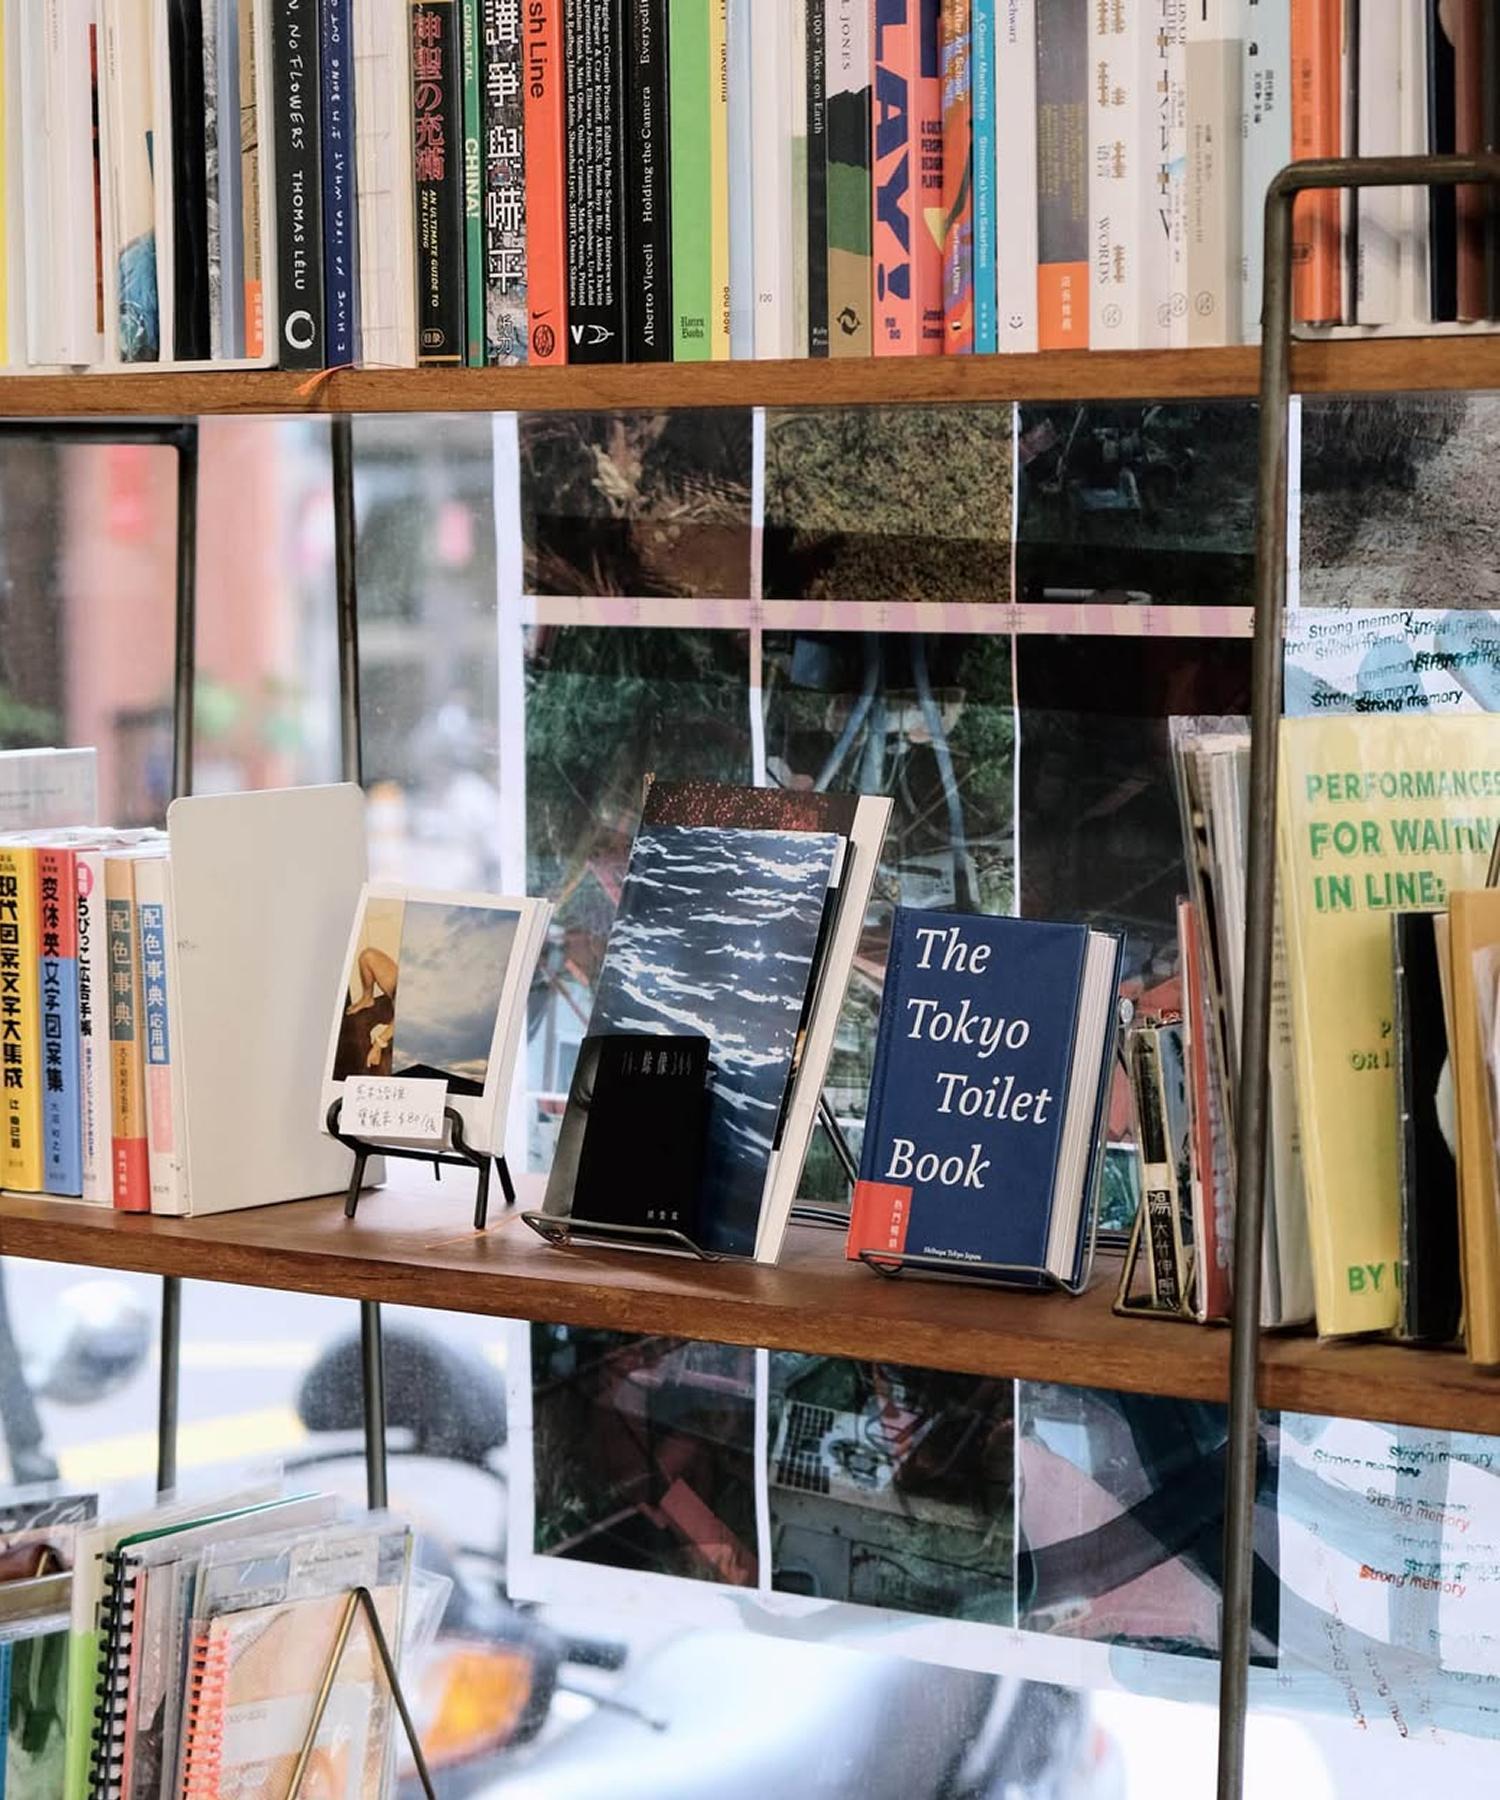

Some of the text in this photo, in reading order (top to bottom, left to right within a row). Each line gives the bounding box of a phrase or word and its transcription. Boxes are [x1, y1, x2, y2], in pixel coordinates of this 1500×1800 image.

[331, 14, 341, 43] OUT
[840, 15, 851, 71] JONES
[956, 36, 965, 53] Art
[529, 41, 546, 99] Line
[603, 45, 612, 83] Creative
[813, 49, 823, 80] Takes
[288, 55, 304, 148] FLOWERS
[604, 84, 612, 123] Practice.
[814, 83, 821, 99] on
[979, 61, 988, 120] Manifesto
[814, 102, 824, 134] Earth
[604, 125, 612, 154] Edited
[641, 86, 655, 223] Holding the Camera
[333, 152, 344, 200] WHAT
[465, 137, 481, 218] CHINA!
[602, 157, 613, 167] by
[605, 170, 613, 187] Ben
[292, 170, 306, 290] THOMAS LÉLU
[422, 189, 430, 248] ZEN LIVING
[429, 189, 440, 308] AN ULTIMATE GUIDE TO
[1098, 216, 1111, 285] WORDS
[336, 291, 346, 332] HAVE
[605, 285, 614, 306] with
[643, 293, 655, 347] Alberto
[1308, 620, 1352, 639] Strong
[1357, 611, 1414, 631] memory
[1406, 690, 1464, 708] memory
[1309, 820, 1382, 858] FOR
[1314, 871, 1445, 909] IN LINE:
[915, 927, 992, 975] The
[906, 998, 1031, 1059] Tokyo
[935, 1072, 1053, 1124] Toilet
[884, 1138, 992, 1190] Book
[1347, 1262, 1386, 1292] BY
[1360, 1564, 1467, 1597] Strong memory
